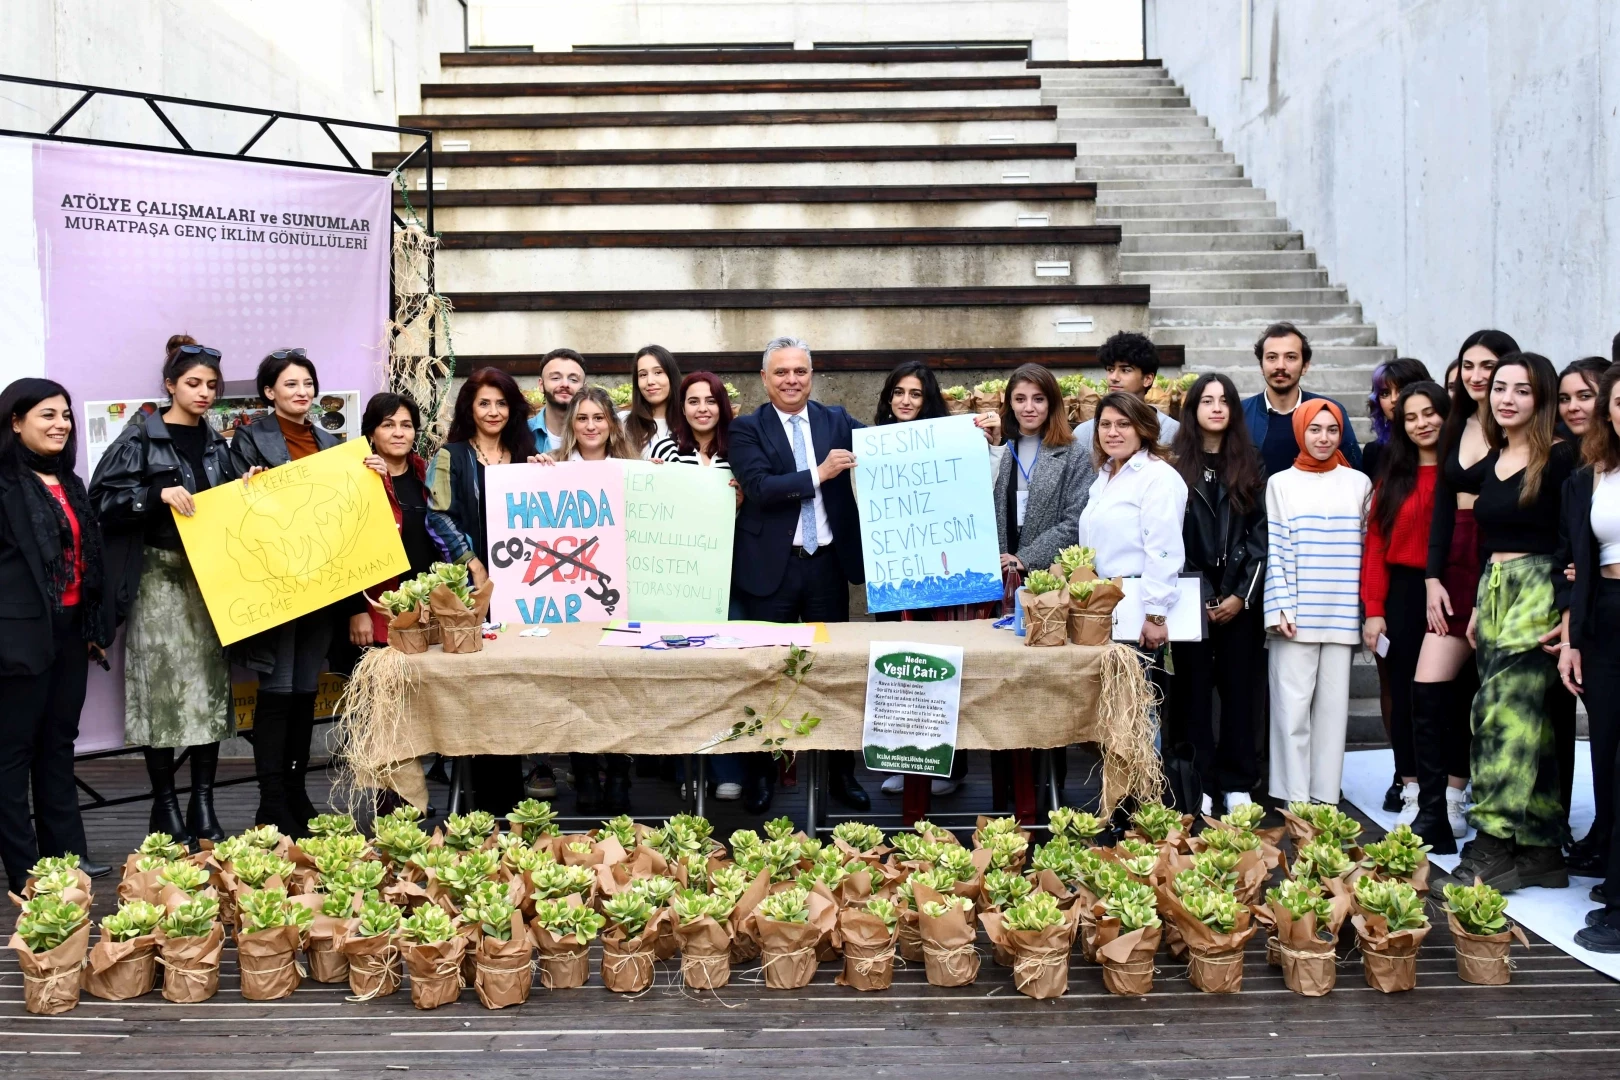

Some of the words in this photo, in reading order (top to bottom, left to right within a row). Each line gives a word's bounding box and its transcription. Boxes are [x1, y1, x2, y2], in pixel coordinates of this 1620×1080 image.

[60, 193, 131, 212] ATÖLYE
[136, 200, 256, 222] ÇALIŞMALARI
[260, 213, 278, 224] ve
[282, 213, 370, 232] SUNUMLAR
[64, 216, 170, 238] MURATPAŞA
[174, 224, 217, 242] GENÇ
[221, 225, 265, 242] İKLİM
[269, 230, 368, 250] GÖNÜLLÜLERİ
[865, 424, 935, 456] SESİNİ
[237, 465, 312, 506] HAREKETE
[866, 458, 962, 490] YÜKSELT
[506, 489, 615, 529] HAVADA
[625, 500, 674, 521] İREYİN
[868, 490, 935, 522] DENİZ
[870, 514, 976, 556] SEVİYESİNİ
[872, 554, 935, 584] DEĞİL
[515, 594, 582, 624] VAR
[883, 662, 910, 679] Yeşil
[912, 665, 937, 679] Çatı
[940, 668, 948, 679] ?
[905, 656, 926, 664] Neden
